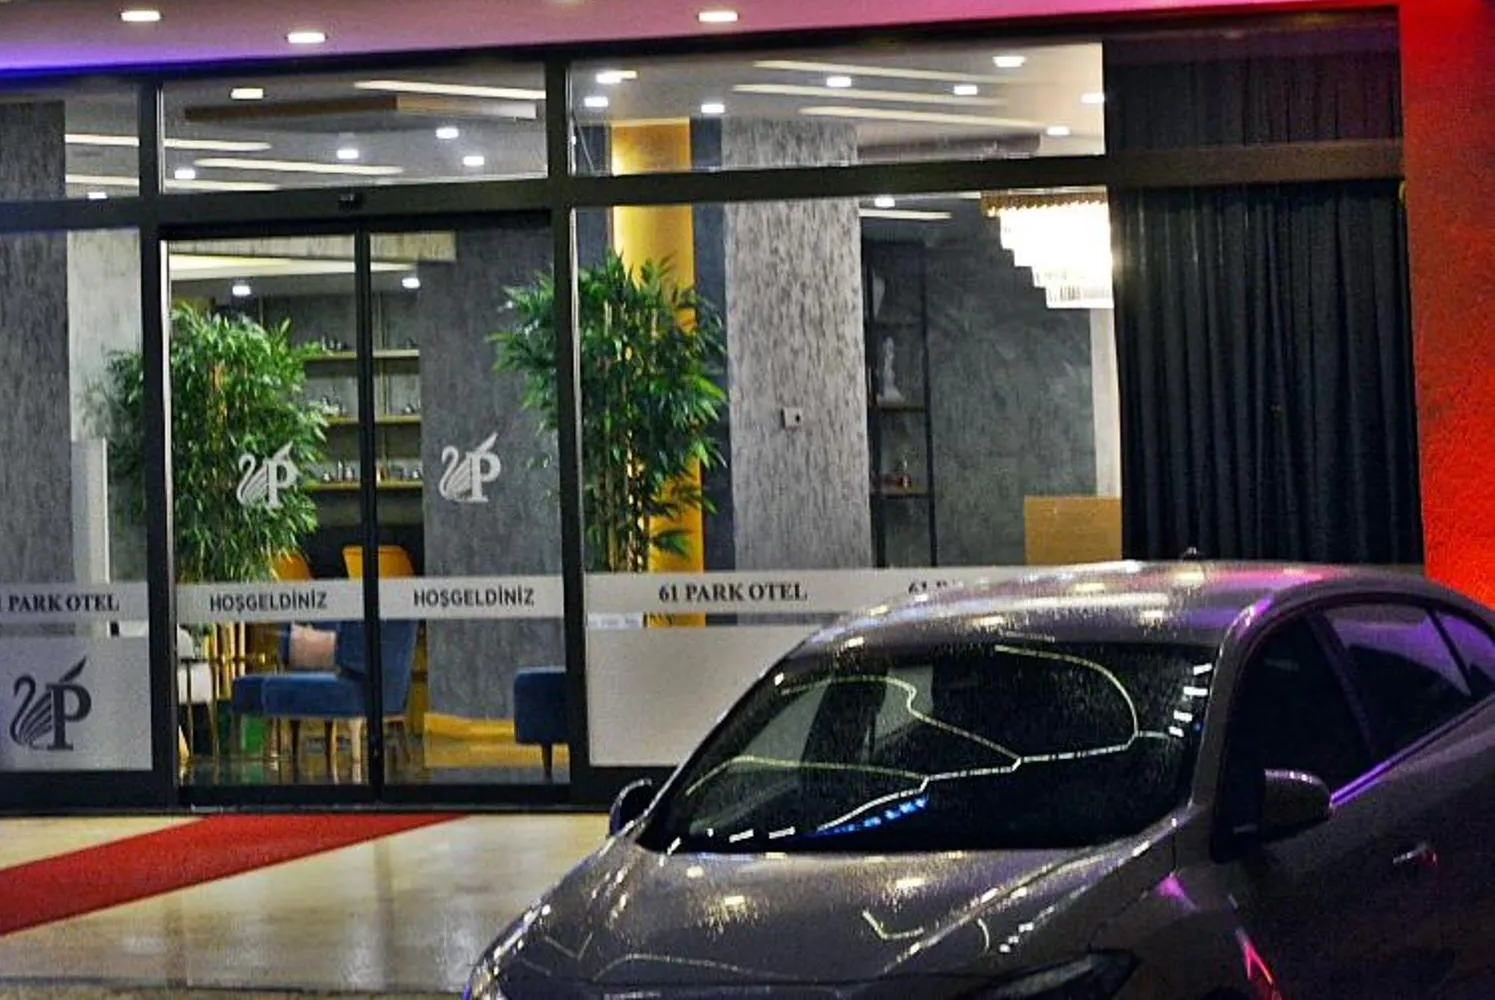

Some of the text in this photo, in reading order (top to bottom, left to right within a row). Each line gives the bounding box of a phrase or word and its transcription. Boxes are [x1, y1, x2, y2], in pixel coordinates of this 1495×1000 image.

[210, 590, 328, 615] HOŞGELDİNİZ
[413, 584, 535, 609] HOŞGELDİNİZ
[659, 582, 808, 601] 61 PARK OTEL
[7, 595, 64, 613] PARK
[65, 593, 120, 612] OTEL
